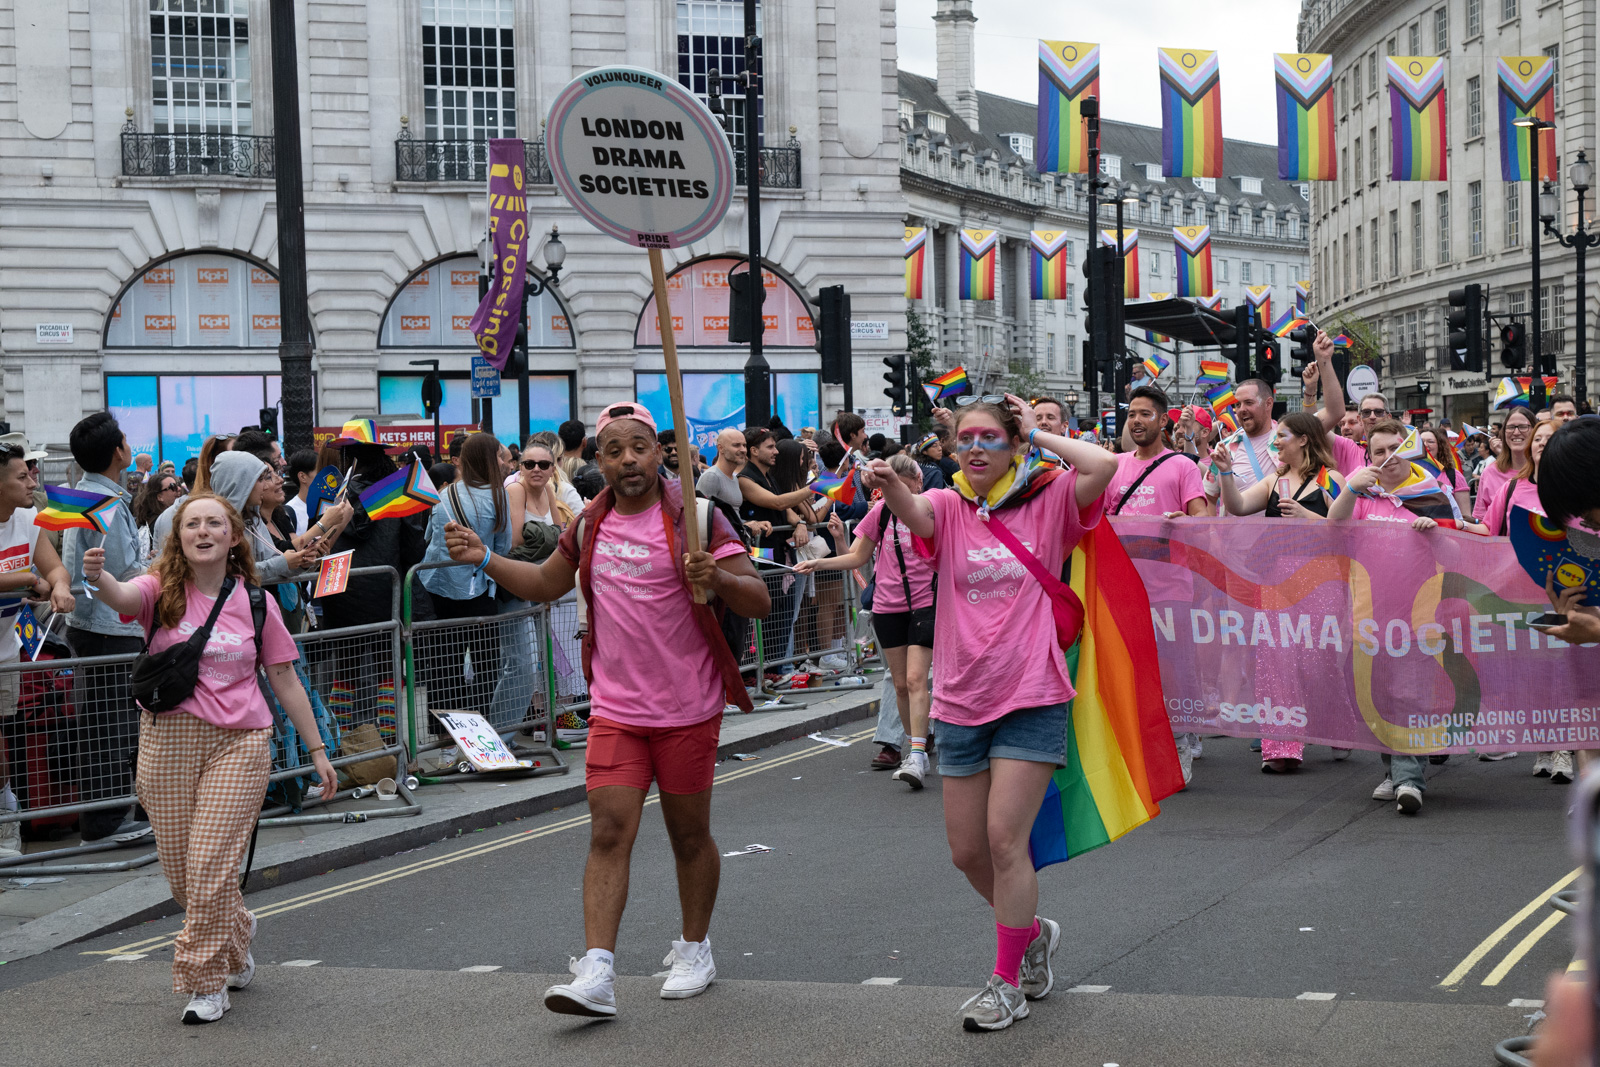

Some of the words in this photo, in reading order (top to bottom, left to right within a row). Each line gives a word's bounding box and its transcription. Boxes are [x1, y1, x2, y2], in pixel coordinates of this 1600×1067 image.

[584, 72, 663, 91] VOLUNQUEER
[581, 117, 684, 141] LONDON
[592, 146, 686, 170] DRAMA
[579, 174, 709, 199] SOCIETIES
[477, 219, 525, 355] Crossing
[865, 418, 890, 427] ECH
[596, 541, 650, 559] sedos
[0, 558, 26, 572] EVER
[628, 562, 653, 579] THEATRE
[967, 564, 996, 584] GEOIDS
[991, 560, 1021, 582] MUSICAL
[1011, 565, 1029, 579] THEA
[967, 588, 1006, 605] Centre
[1190, 608, 1343, 653] DRAMA
[206, 667, 236, 682] Stage
[1163, 695, 1205, 714] tage
[1219, 697, 1308, 727] sedos
[1408, 709, 1526, 729] ENCOURAGING
[1408, 733, 1425, 748] IN
[1432, 729, 1516, 747] LONDON'S
[1521, 726, 1600, 745] AMATEUR
